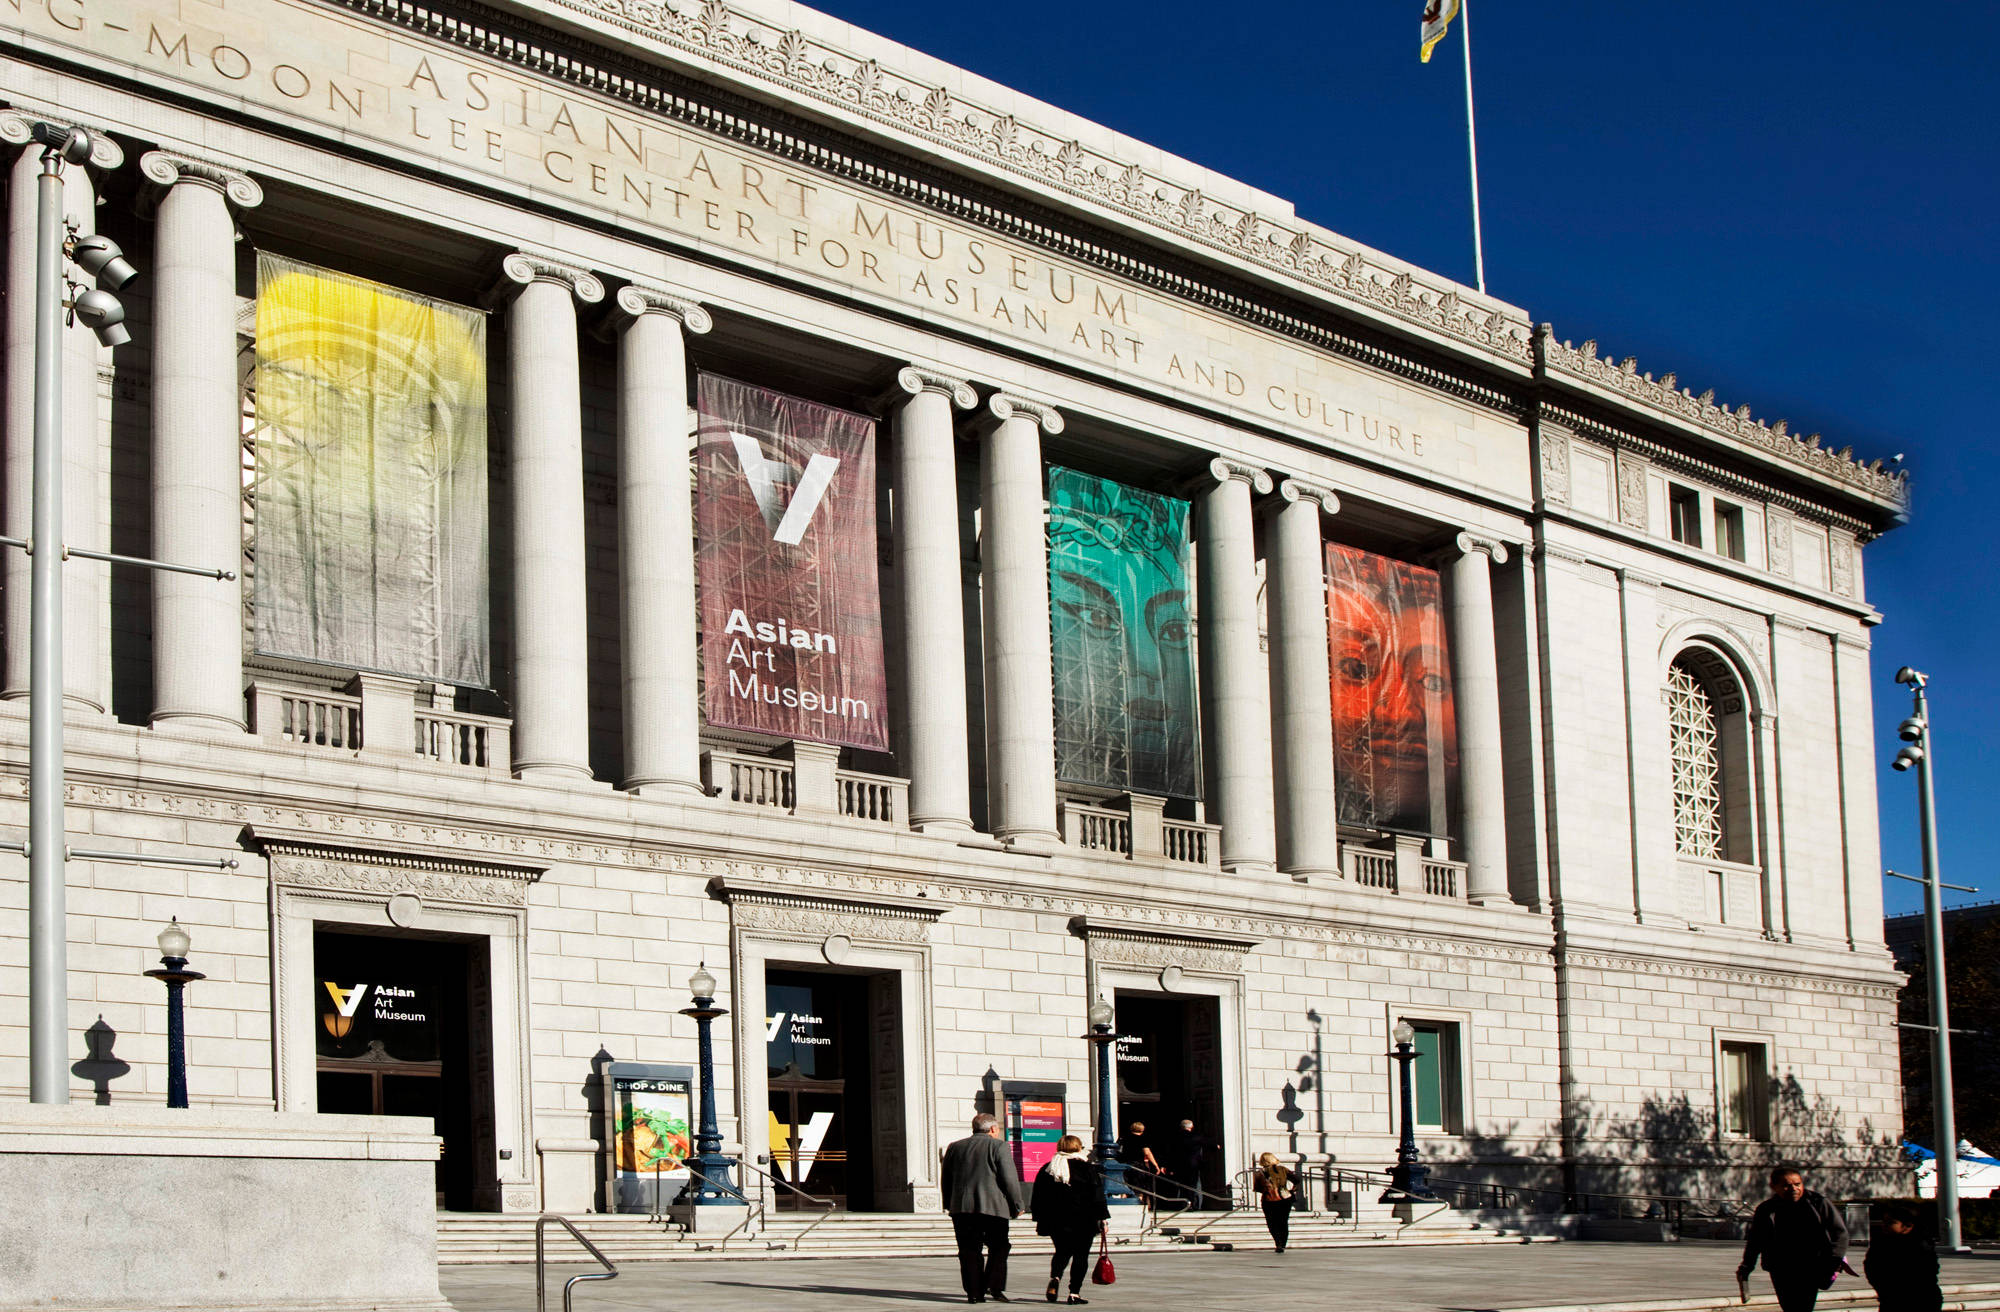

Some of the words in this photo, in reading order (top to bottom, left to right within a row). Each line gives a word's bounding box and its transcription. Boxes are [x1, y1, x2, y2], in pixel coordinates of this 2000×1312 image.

[402, 55, 644, 165] ASIAN
[684, 148, 818, 219] ART
[852, 202, 1130, 326] MUSEUM
[407, 105, 503, 162] LEE
[544, 150, 762, 245] CENTER
[791, 228, 886, 284] FOR
[912, 268, 1048, 335] ASIAN
[1071, 321, 1145, 364] ART
[1167, 353, 1246, 397] AND
[1266, 385, 1425, 458] CULTURE
[724, 608, 837, 655] Asian
[726, 638, 777, 673] Art
[728, 668, 869, 720] Museum
[374, 985, 415, 997] Asian
[374, 997, 393, 1008] Art
[375, 1009, 425, 1021] Museum
[790, 1013, 822, 1023] Asian
[790, 1024, 806, 1034] Art
[791, 1034, 831, 1045] Museum
[1117, 1043, 1129, 1052] Art
[1117, 1053, 1149, 1061] Museum
[616, 1081, 649, 1091] SHOP
[658, 1083, 684, 1092] DINE
